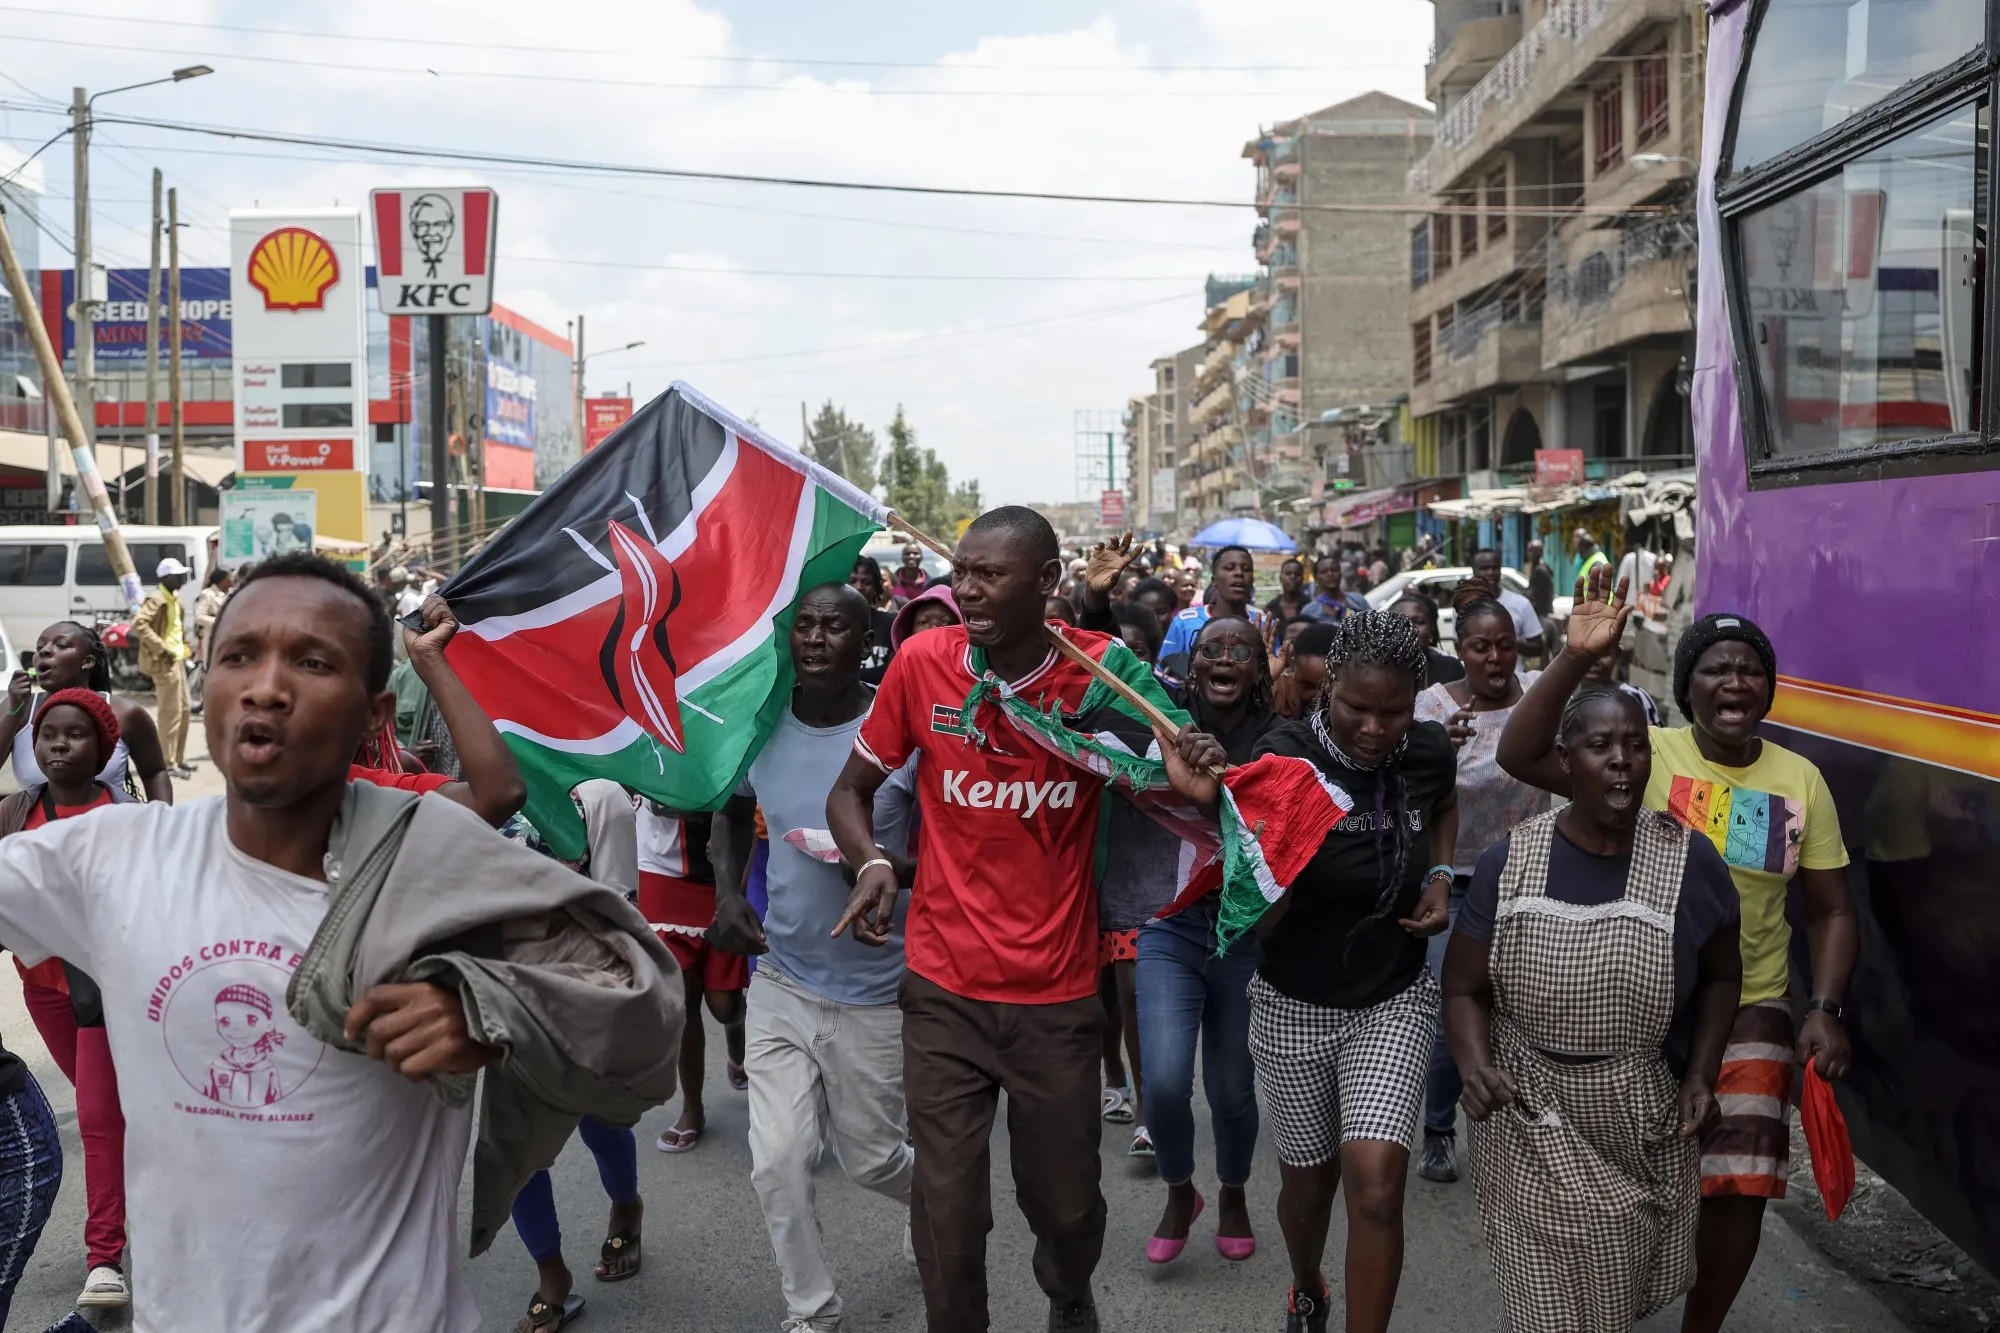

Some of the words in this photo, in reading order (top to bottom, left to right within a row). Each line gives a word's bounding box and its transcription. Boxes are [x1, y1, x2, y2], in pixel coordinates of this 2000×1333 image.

[396, 283, 471, 308] KFC
[92, 300, 148, 322] SEED
[265, 454, 327, 466] V-Power
[942, 769, 1078, 819] Kenya
[147, 955, 194, 1023] UNIDOS
[199, 940, 282, 961] CONTRA
[185, 1104, 236, 1120] MEMORIAL
[239, 1111, 264, 1122] PEPE
[267, 1112, 315, 1123] ALVAREZ
